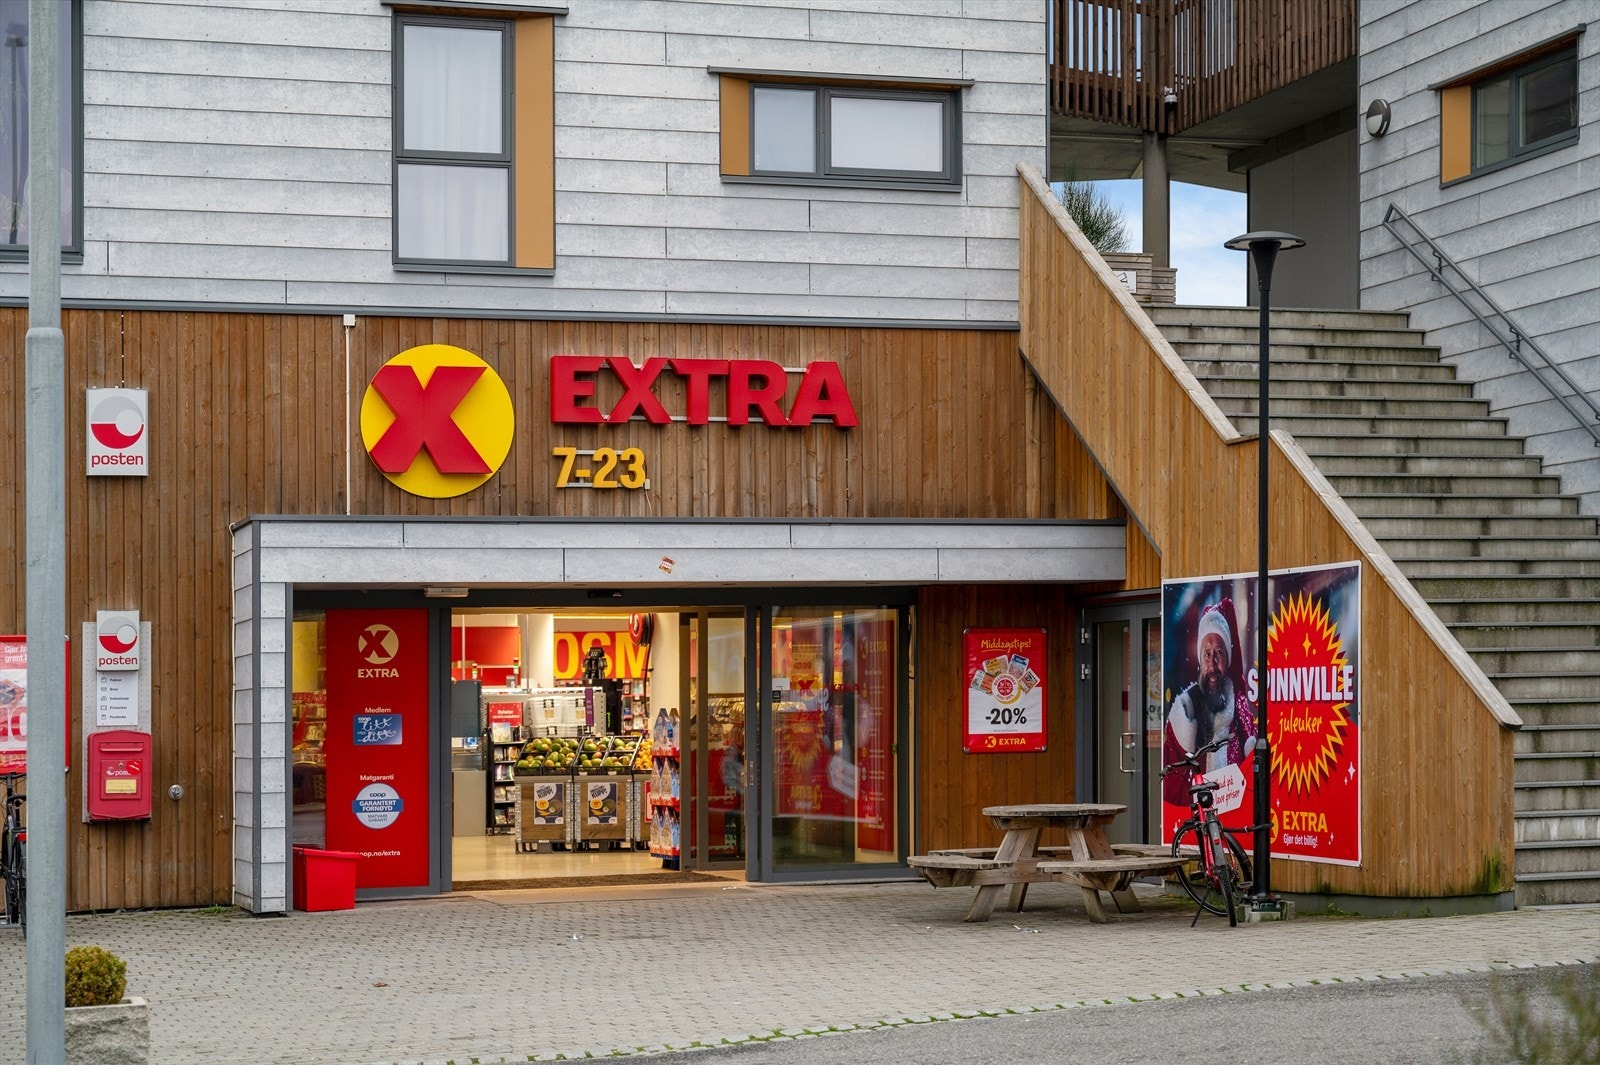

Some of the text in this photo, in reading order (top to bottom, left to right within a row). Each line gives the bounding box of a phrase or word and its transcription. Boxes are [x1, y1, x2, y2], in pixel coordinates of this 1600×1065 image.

[550, 355, 859, 428] EXTRA
[91, 452, 144, 468] posten
[552, 447, 646, 489] 7-23
[981, 638, 1031, 653] Middagstips!
[98, 655, 138, 667] posten
[357, 668, 399, 678] EXTRA
[985, 707, 1027, 725] -20%
[1278, 707, 1323, 744] juleuker
[998, 737, 1026, 746] EXTRA
[359, 774, 394, 782] Matgaranti
[1282, 810, 1328, 833] EXTRA
[1283, 834, 1318, 848] Gjør det billig!
[358, 850, 401, 858] op.no/extra
